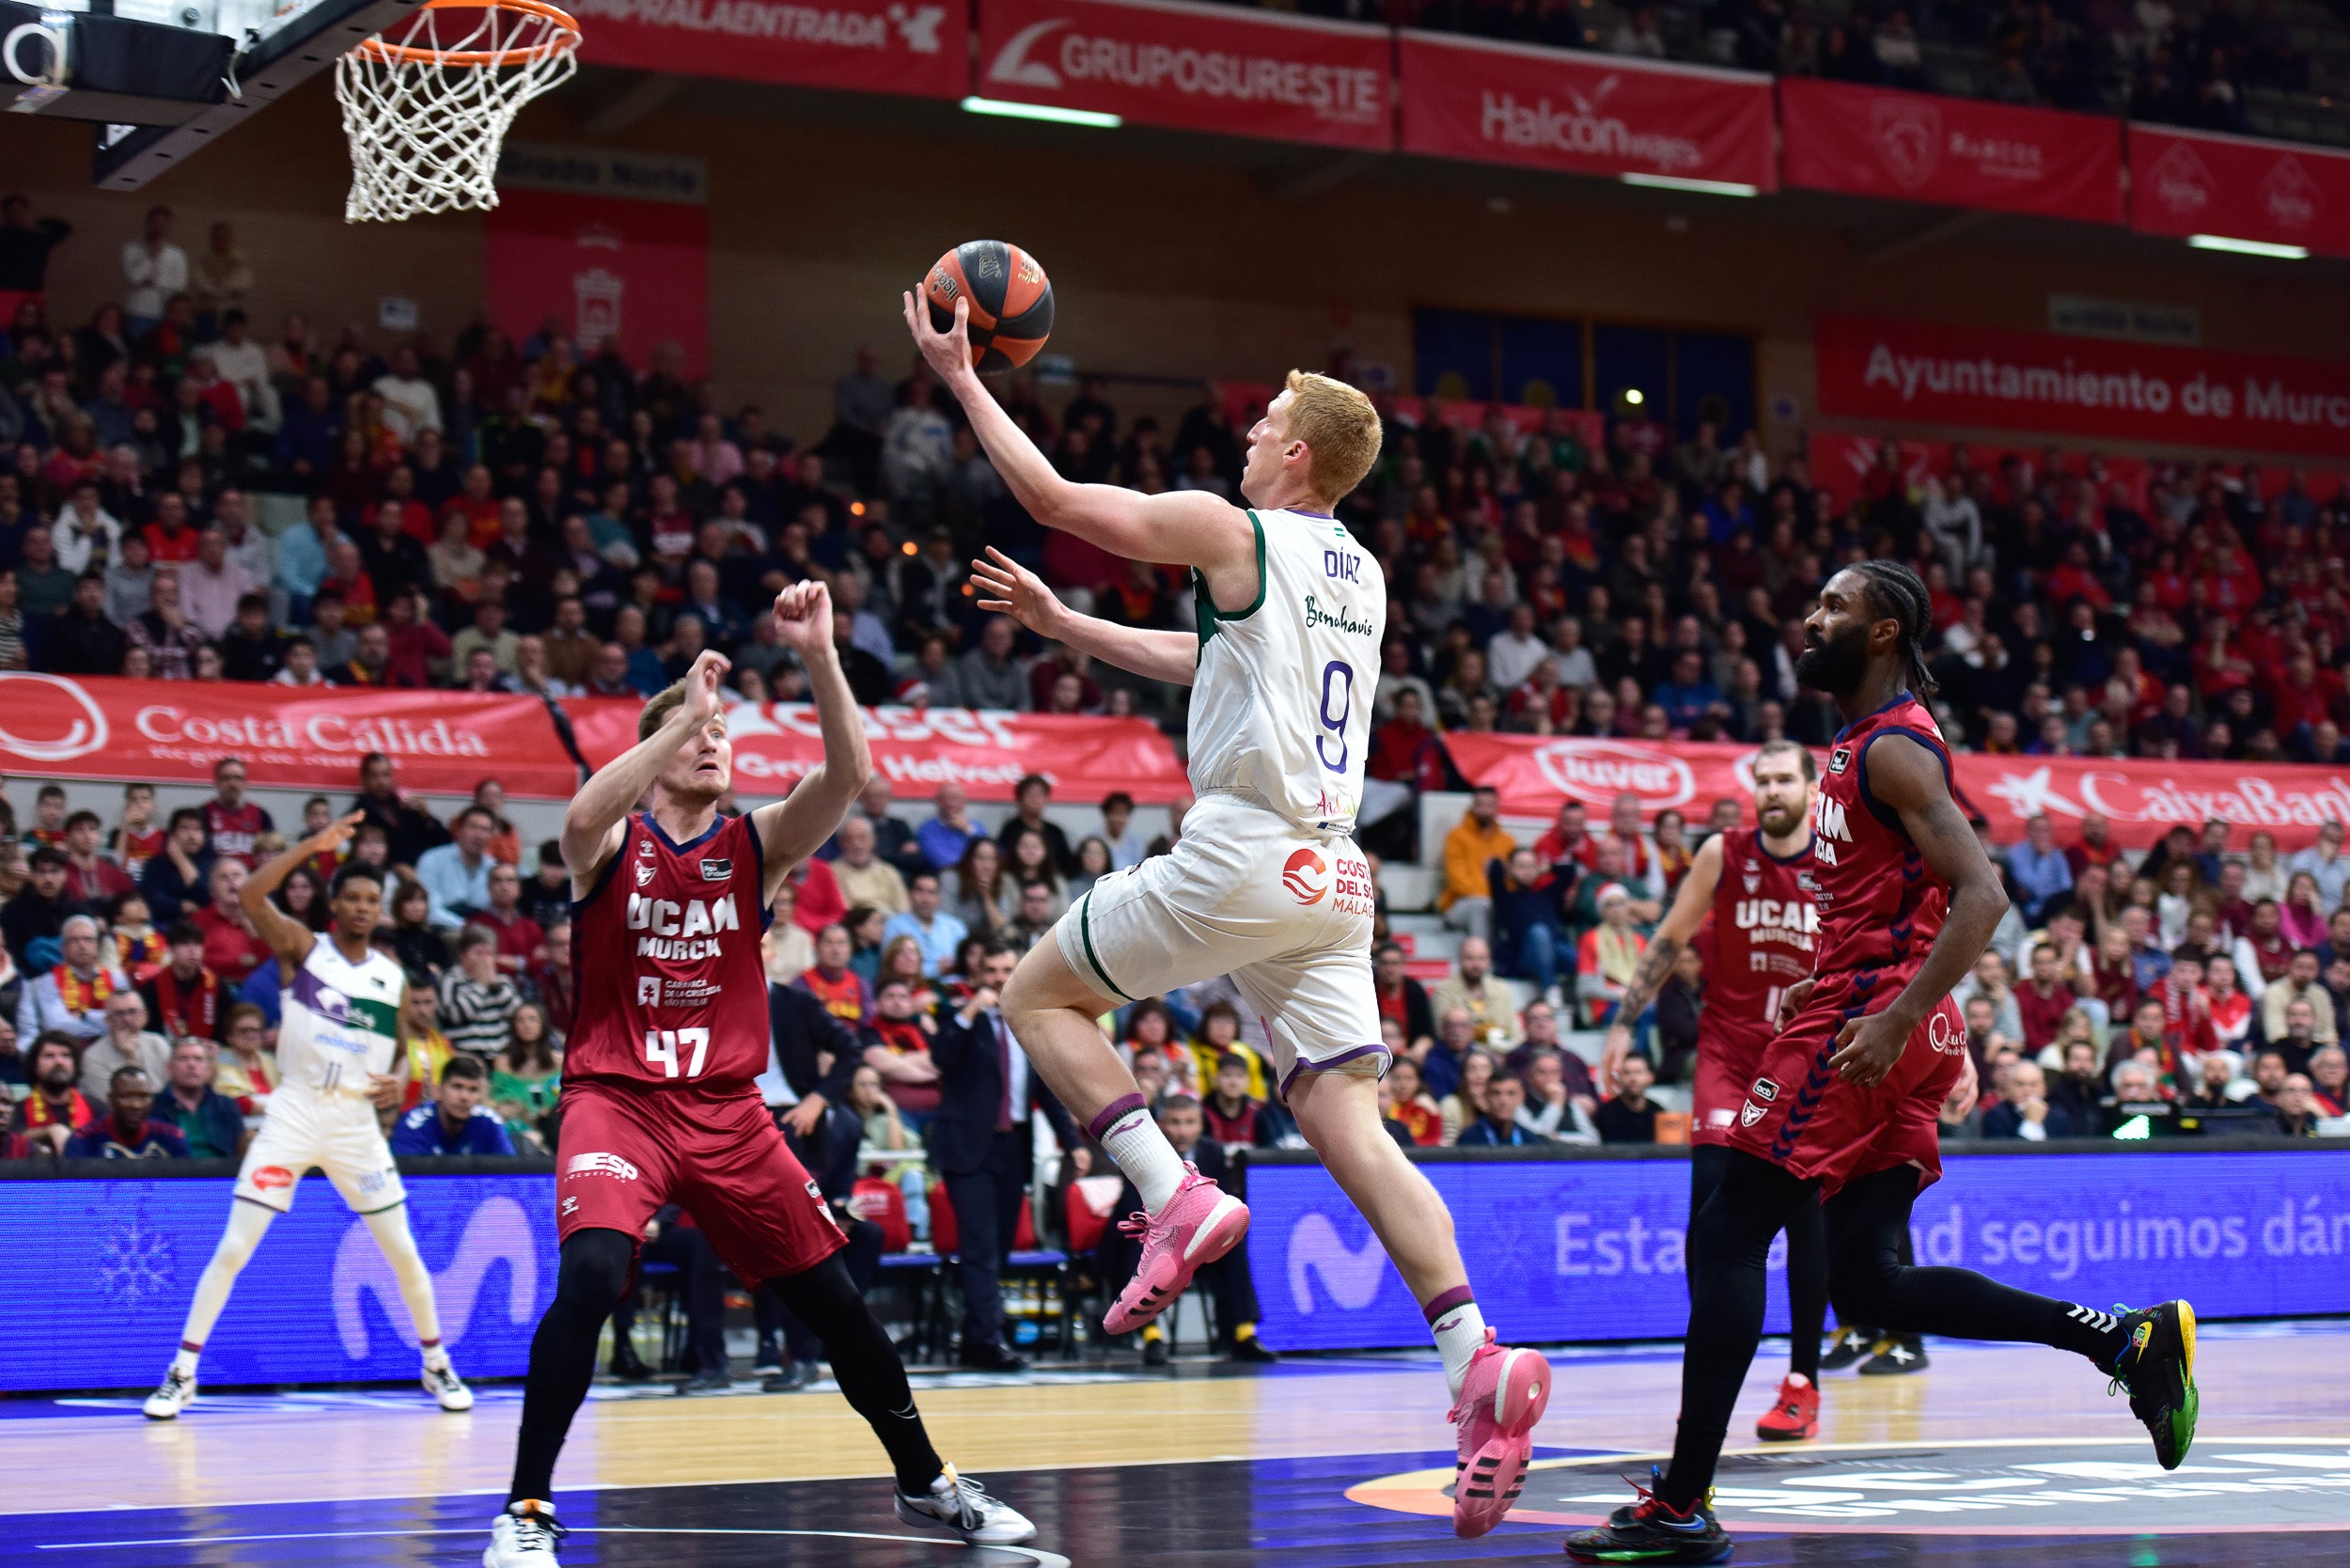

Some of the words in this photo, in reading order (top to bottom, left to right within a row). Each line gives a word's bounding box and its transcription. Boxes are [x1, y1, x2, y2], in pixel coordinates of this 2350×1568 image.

[1060, 34, 1380, 114] GRUPOSURESTE
[1864, 341, 2171, 404] Ayuntamiento
[2181, 375, 2233, 419] de
[1324, 546, 1361, 585] DÍAZ
[135, 704, 300, 749] Costa
[306, 713, 489, 758] Cálida
[1315, 660, 1354, 775] 9
[1336, 878, 1362, 897] DEL
[627, 892, 741, 938] UCAM
[636, 936, 723, 961] MURCIA
[646, 1027, 710, 1079] 47
[1756, 1085, 1772, 1097] acb
[566, 1152, 638, 1181] ESP
[1980, 1200, 2248, 1279] seguimos
